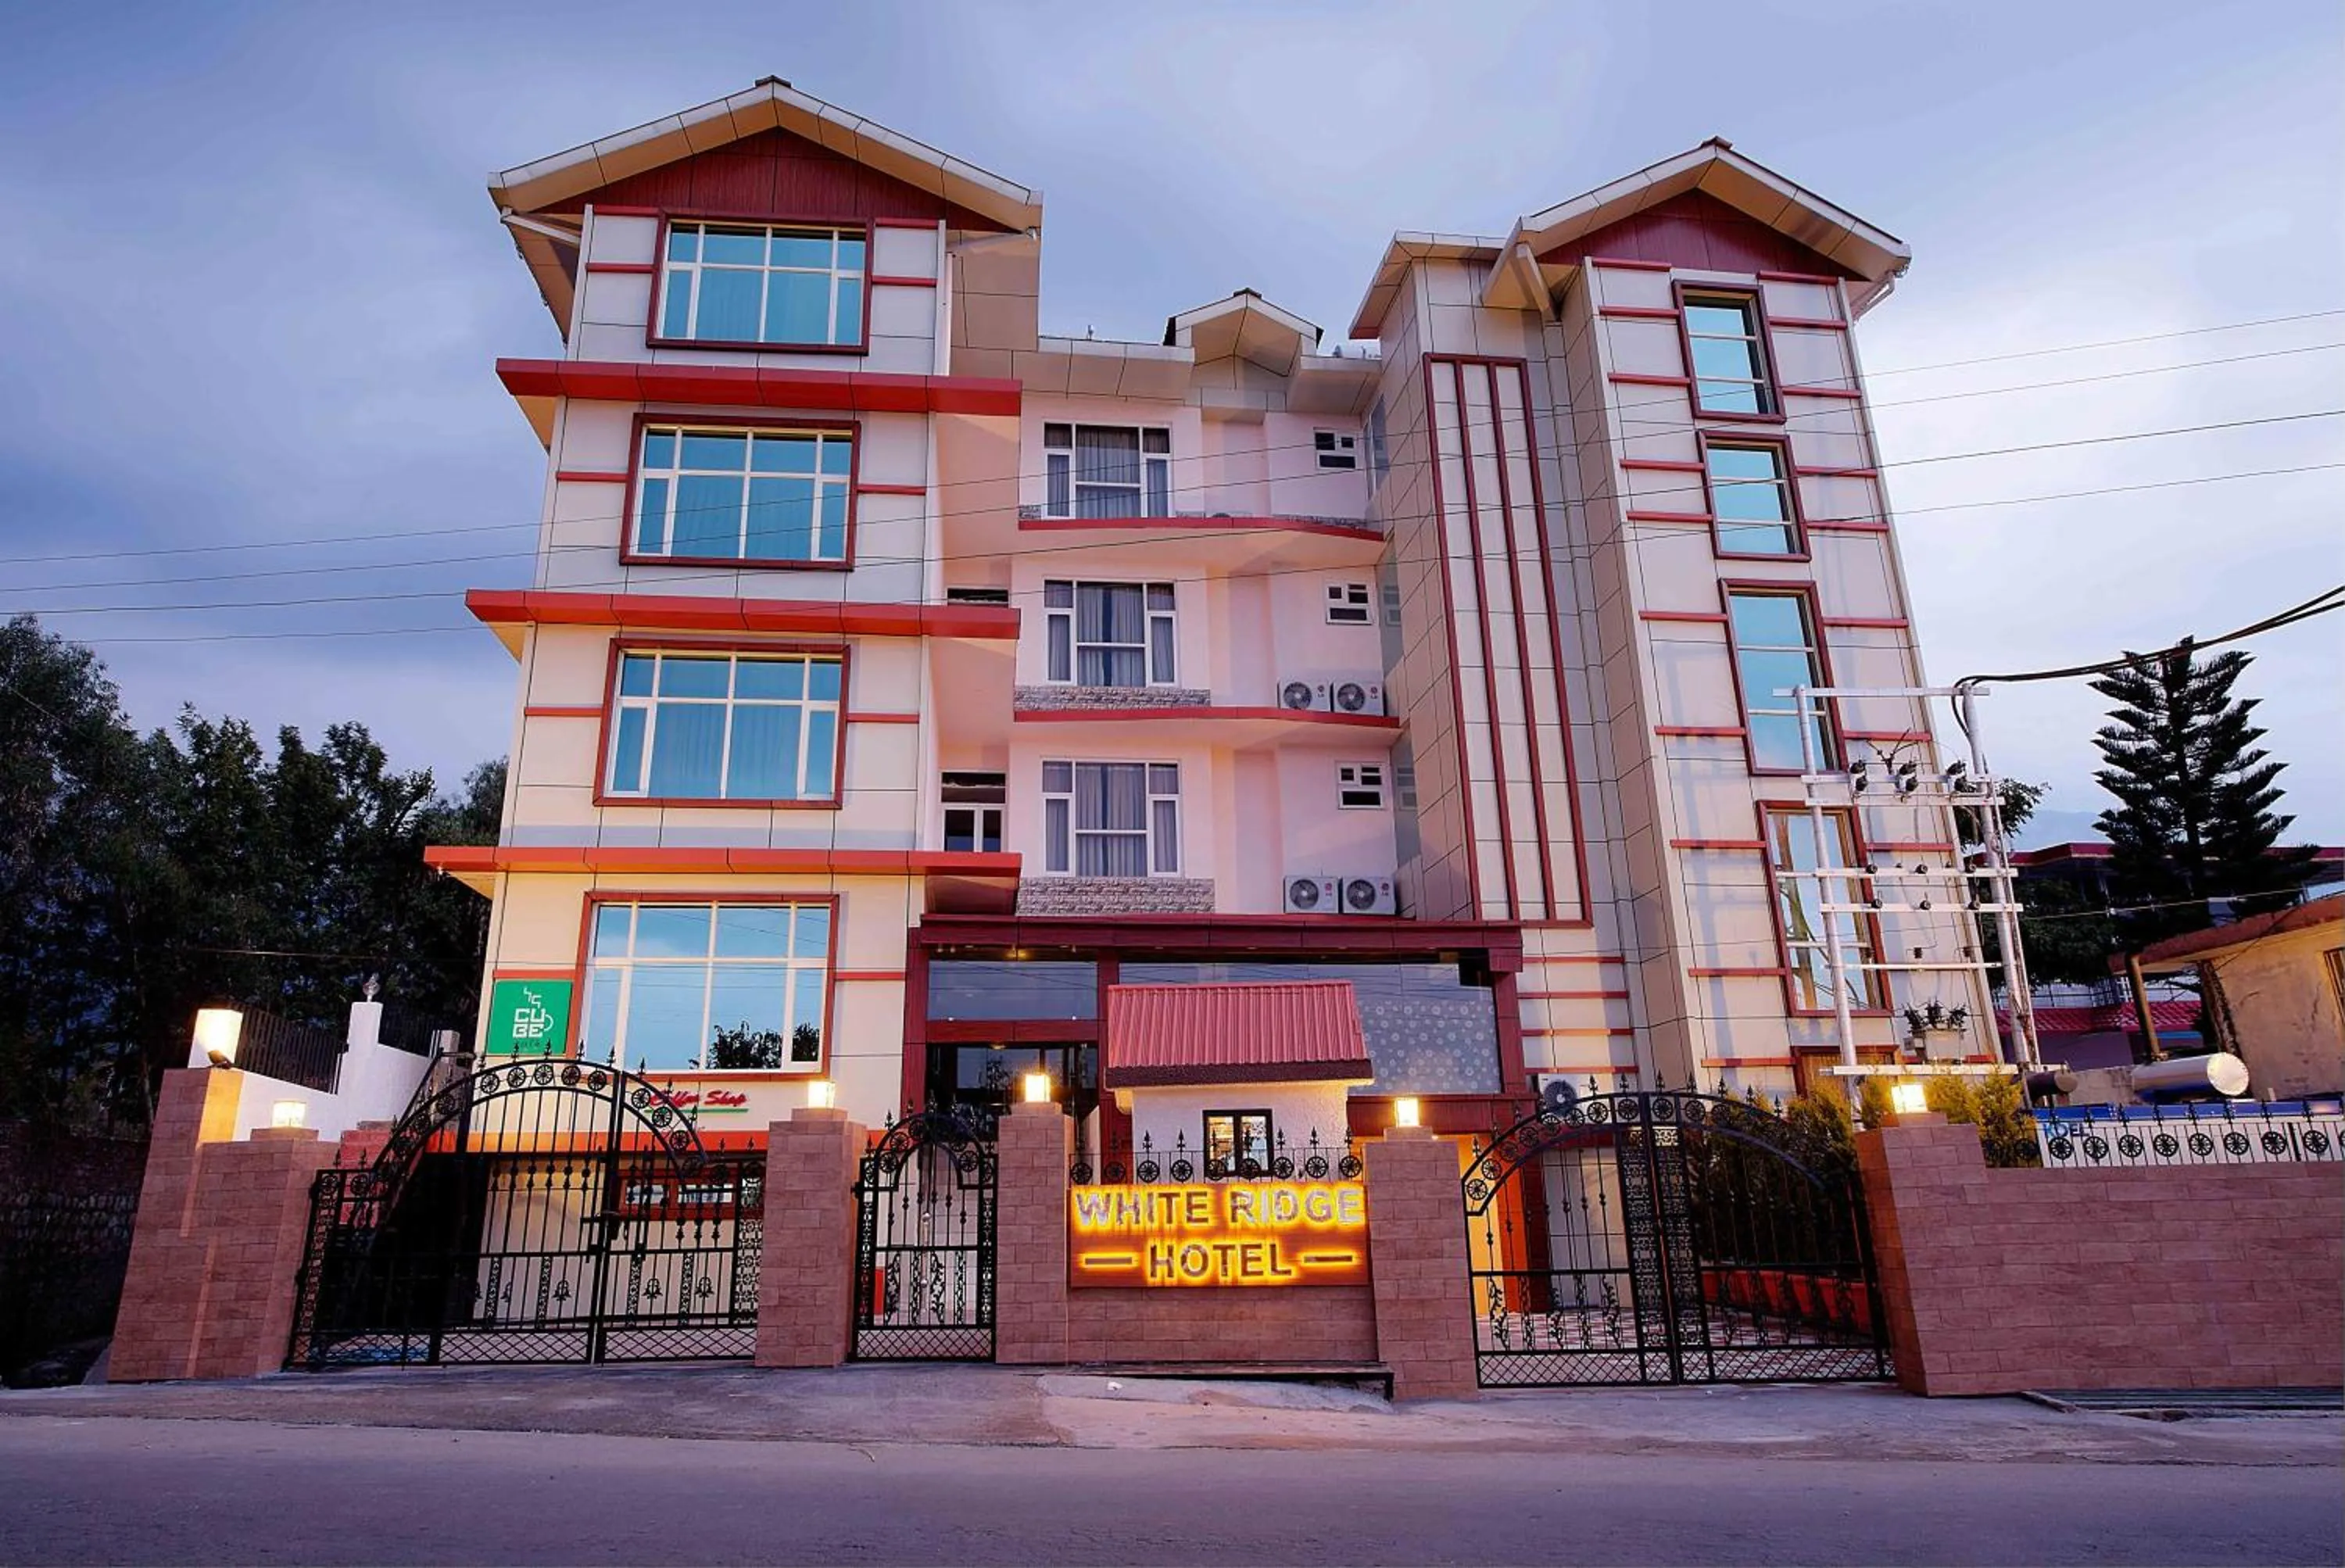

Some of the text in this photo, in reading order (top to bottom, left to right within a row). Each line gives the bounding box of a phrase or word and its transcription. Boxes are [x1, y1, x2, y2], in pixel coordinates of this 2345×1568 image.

[650, 1089, 747, 1108] Cffee Shop
[1076, 1189, 1362, 1226] WHITE RIDGE
[1150, 1244, 1292, 1278] HOTEL
